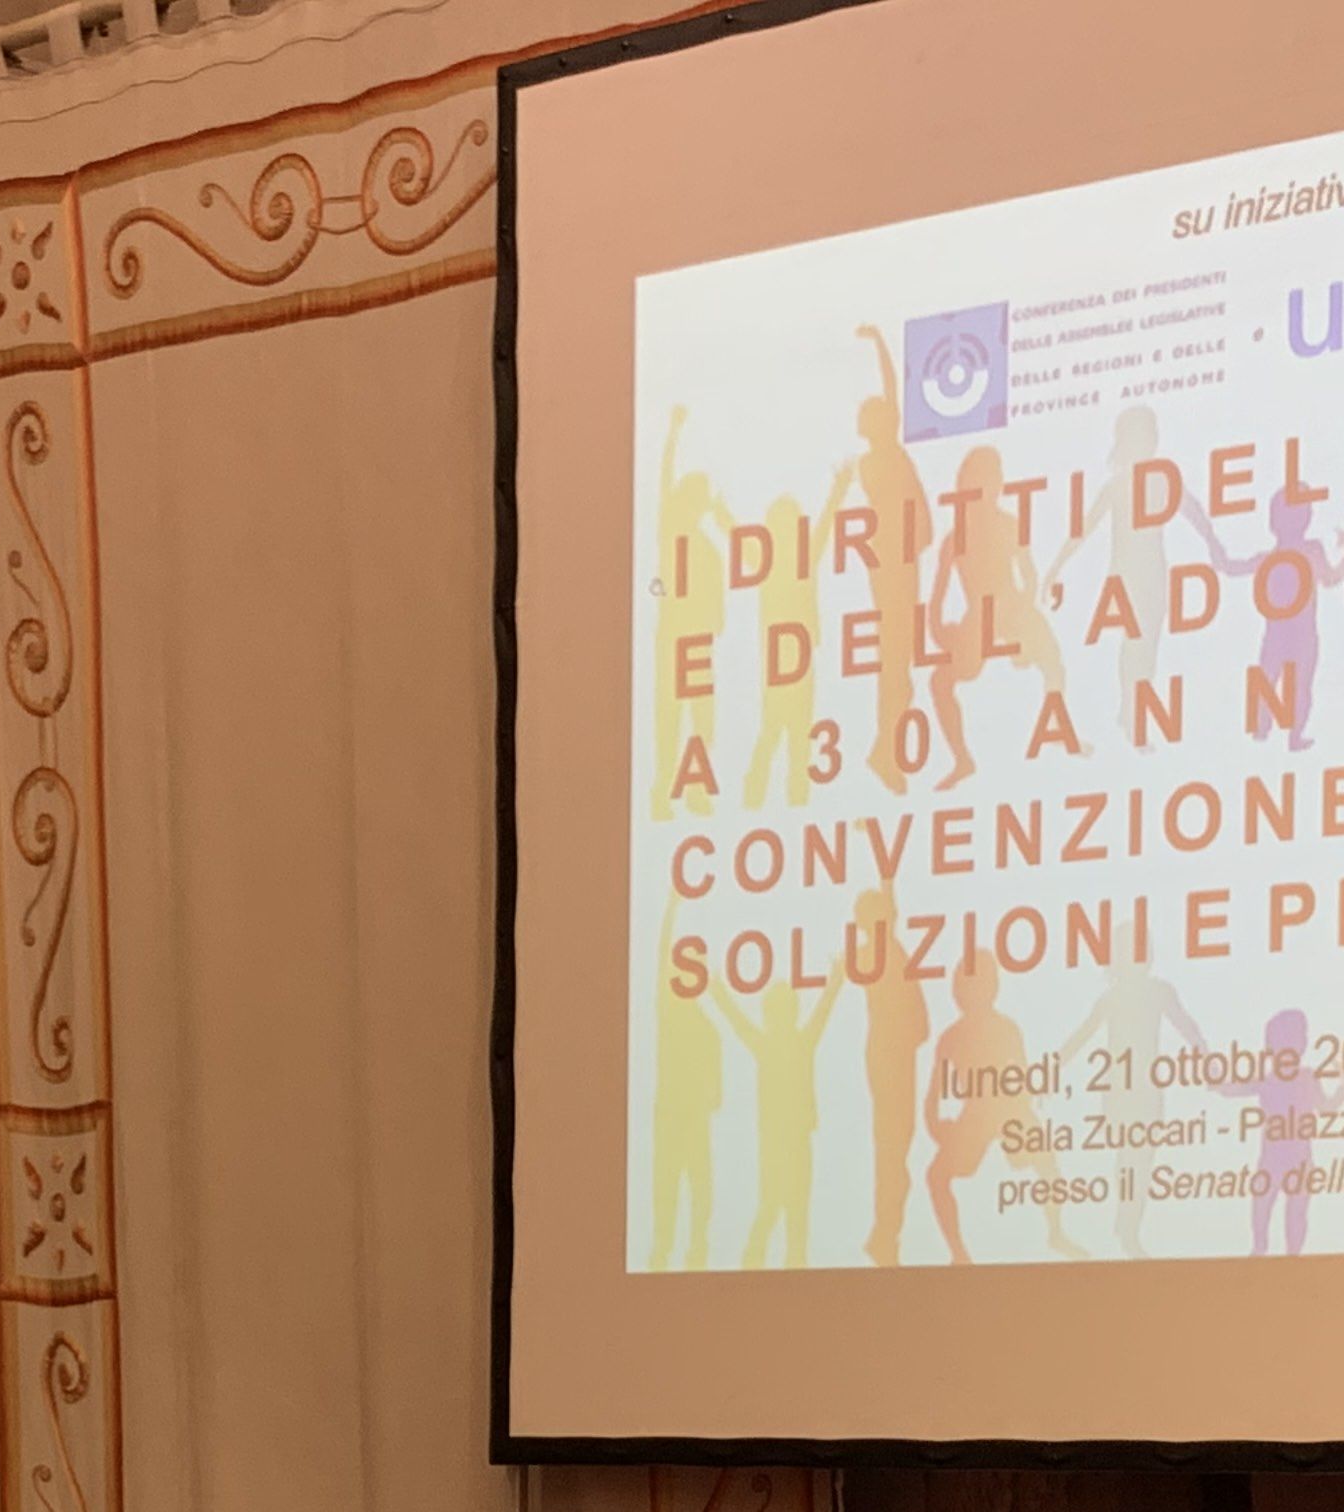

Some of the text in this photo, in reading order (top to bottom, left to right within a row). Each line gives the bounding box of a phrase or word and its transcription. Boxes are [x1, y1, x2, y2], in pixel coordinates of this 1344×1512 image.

[1171, 203, 1214, 239] su
[1011, 270, 1227, 322] CONFERENZA DEI PRESIDENTI
[1011, 303, 1226, 353] DELLE ASSEMBLEE LEGISLATIVE
[1011, 338, 1226, 388] DELLE REGIONI E DELLE
[1011, 369, 1226, 418] PROVINCE AUTONOME
[675, 535, 689, 598] I
[729, 471, 1084, 590] DIRITTI
[675, 633, 714, 699] E
[670, 735, 719, 799] A
[807, 707, 930, 784] 30
[669, 895, 1148, 999] SOLUZIONI
[1185, 888, 1230, 959] E
[941, 1051, 1072, 1099] lunedì,
[1086, 1047, 1134, 1093] 21
[1149, 1040, 1301, 1089] ottobre
[1000, 1118, 1073, 1154] Sala
[1081, 1110, 1207, 1150] Zuccari
[998, 1177, 1108, 1214] presso
[1119, 1167, 1135, 1201] il
[1148, 1164, 1271, 1201] Senato
